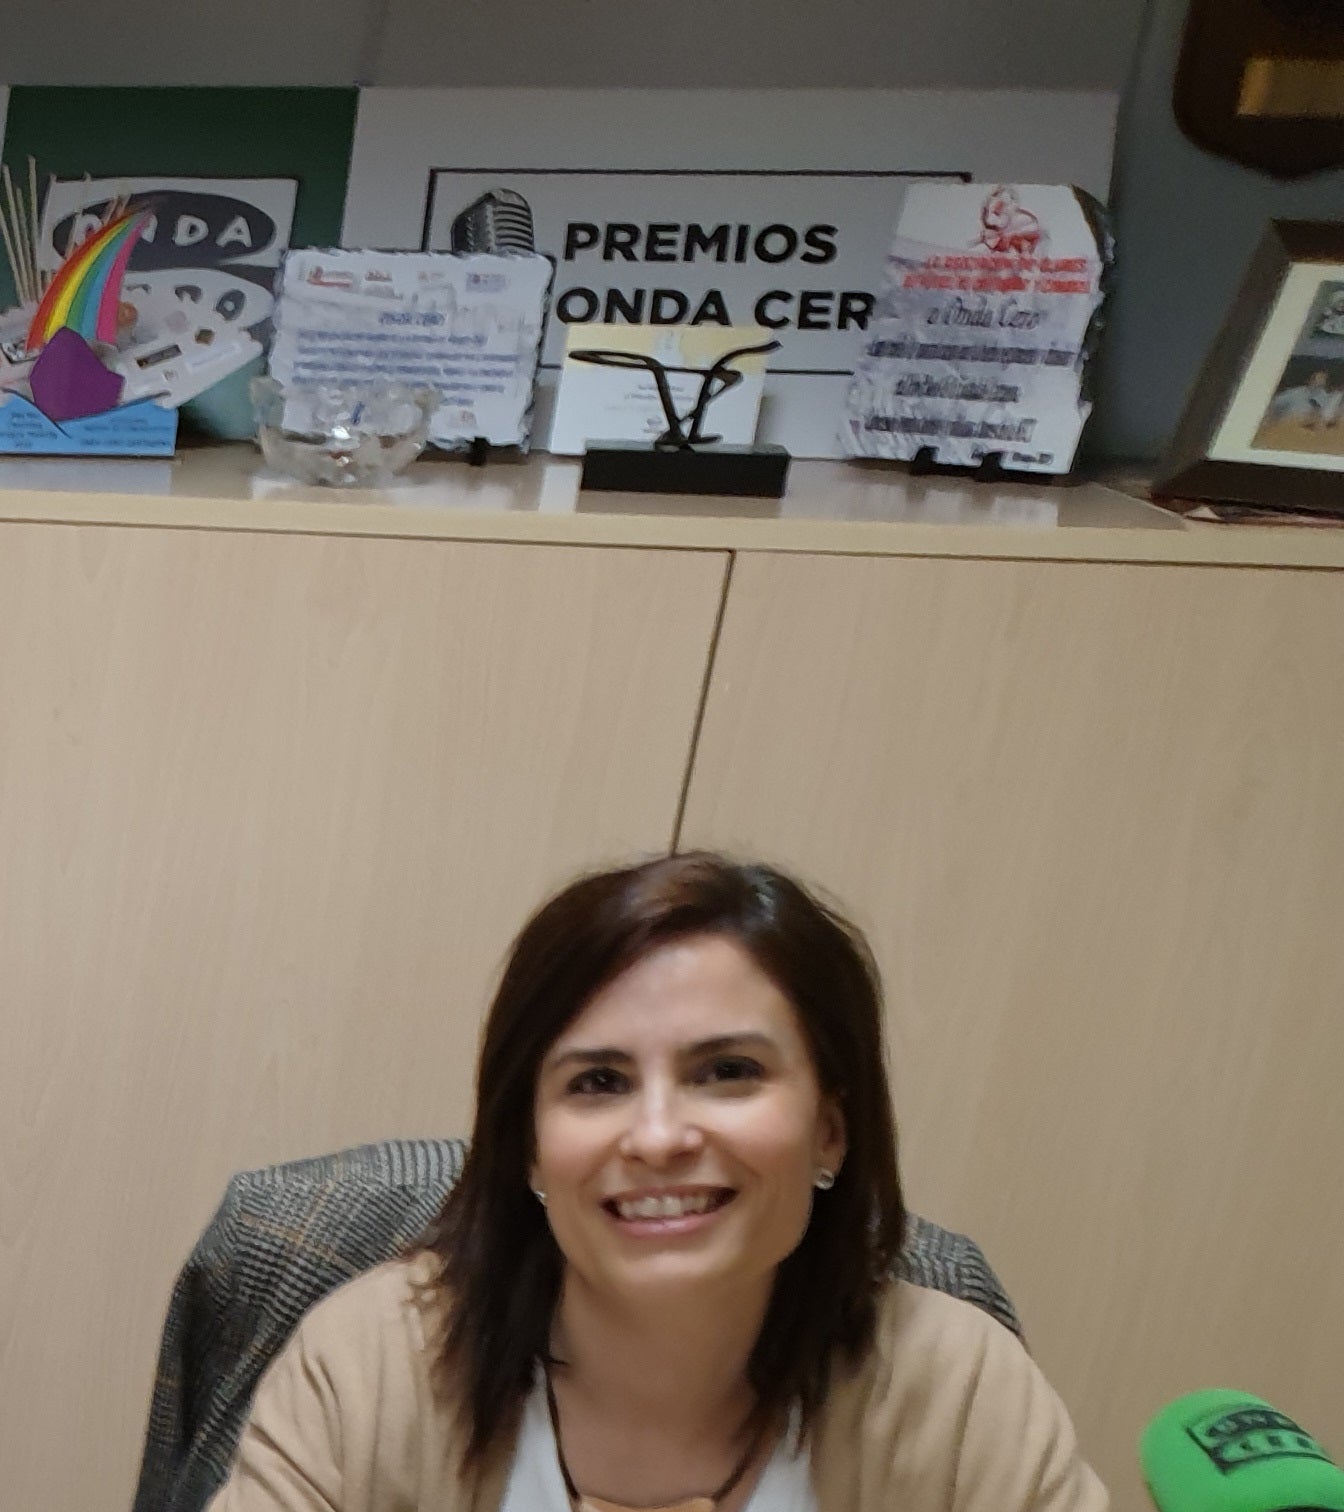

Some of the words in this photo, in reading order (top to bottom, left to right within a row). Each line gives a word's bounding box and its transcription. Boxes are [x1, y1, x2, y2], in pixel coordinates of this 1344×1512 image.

[564, 222, 839, 264] PREMIOS
[556, 287, 733, 326] ONDA
[754, 289, 877, 331] CER
